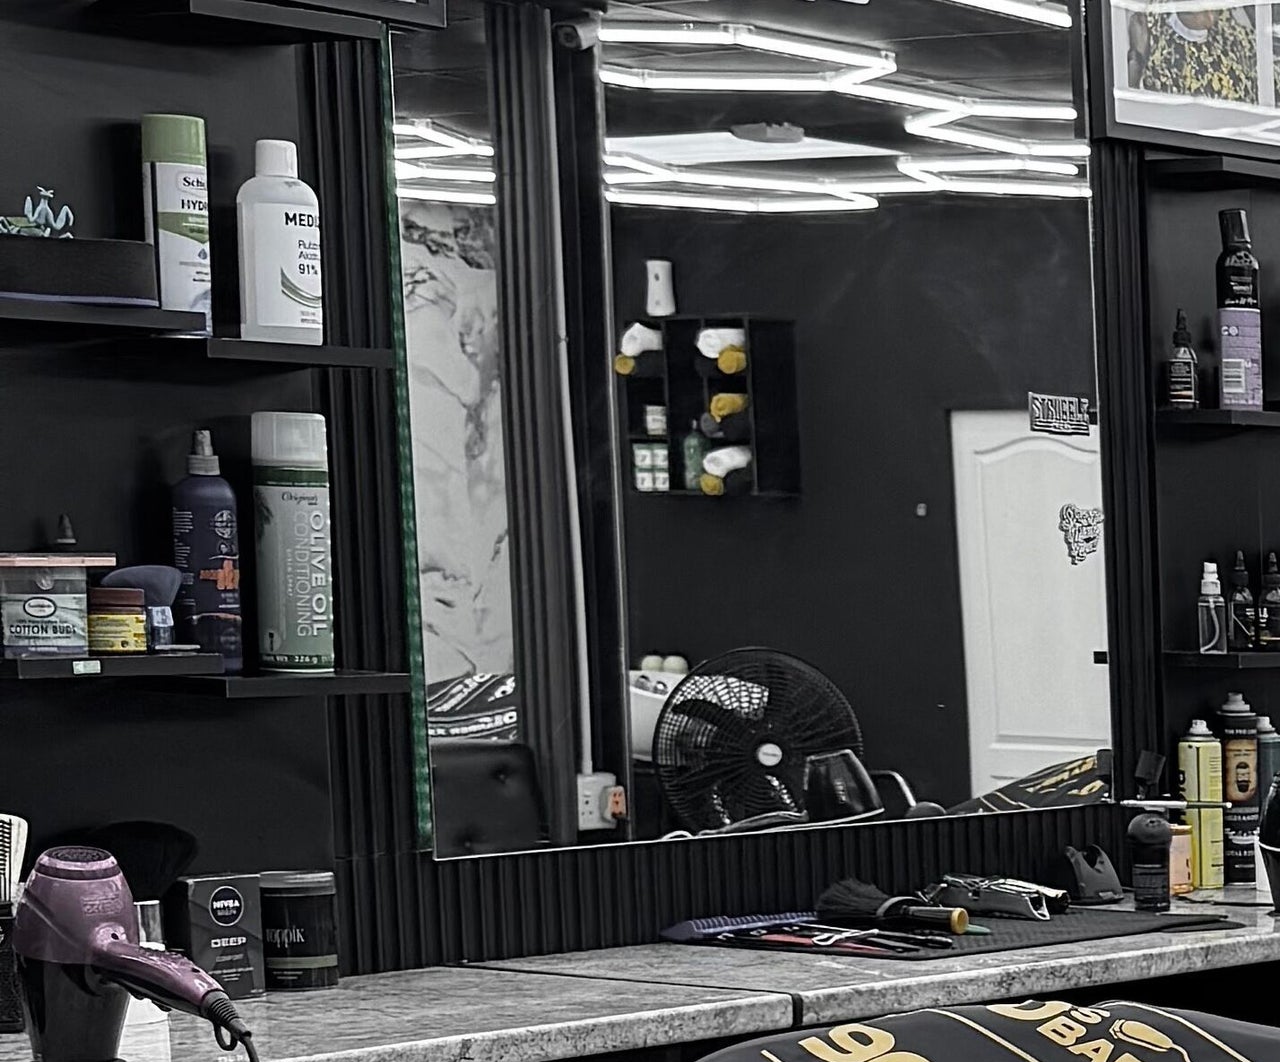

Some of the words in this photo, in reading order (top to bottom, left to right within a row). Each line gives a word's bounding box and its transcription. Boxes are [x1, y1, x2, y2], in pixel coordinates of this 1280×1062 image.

[310, 511, 327, 588] OLIVE
[294, 511, 312, 638] CONDITIONING
[311, 593, 329, 637] OIL
[10, 624, 49, 635] COTTON
[212, 899, 240, 910] NIVEA
[211, 935, 247, 948] DEEP
